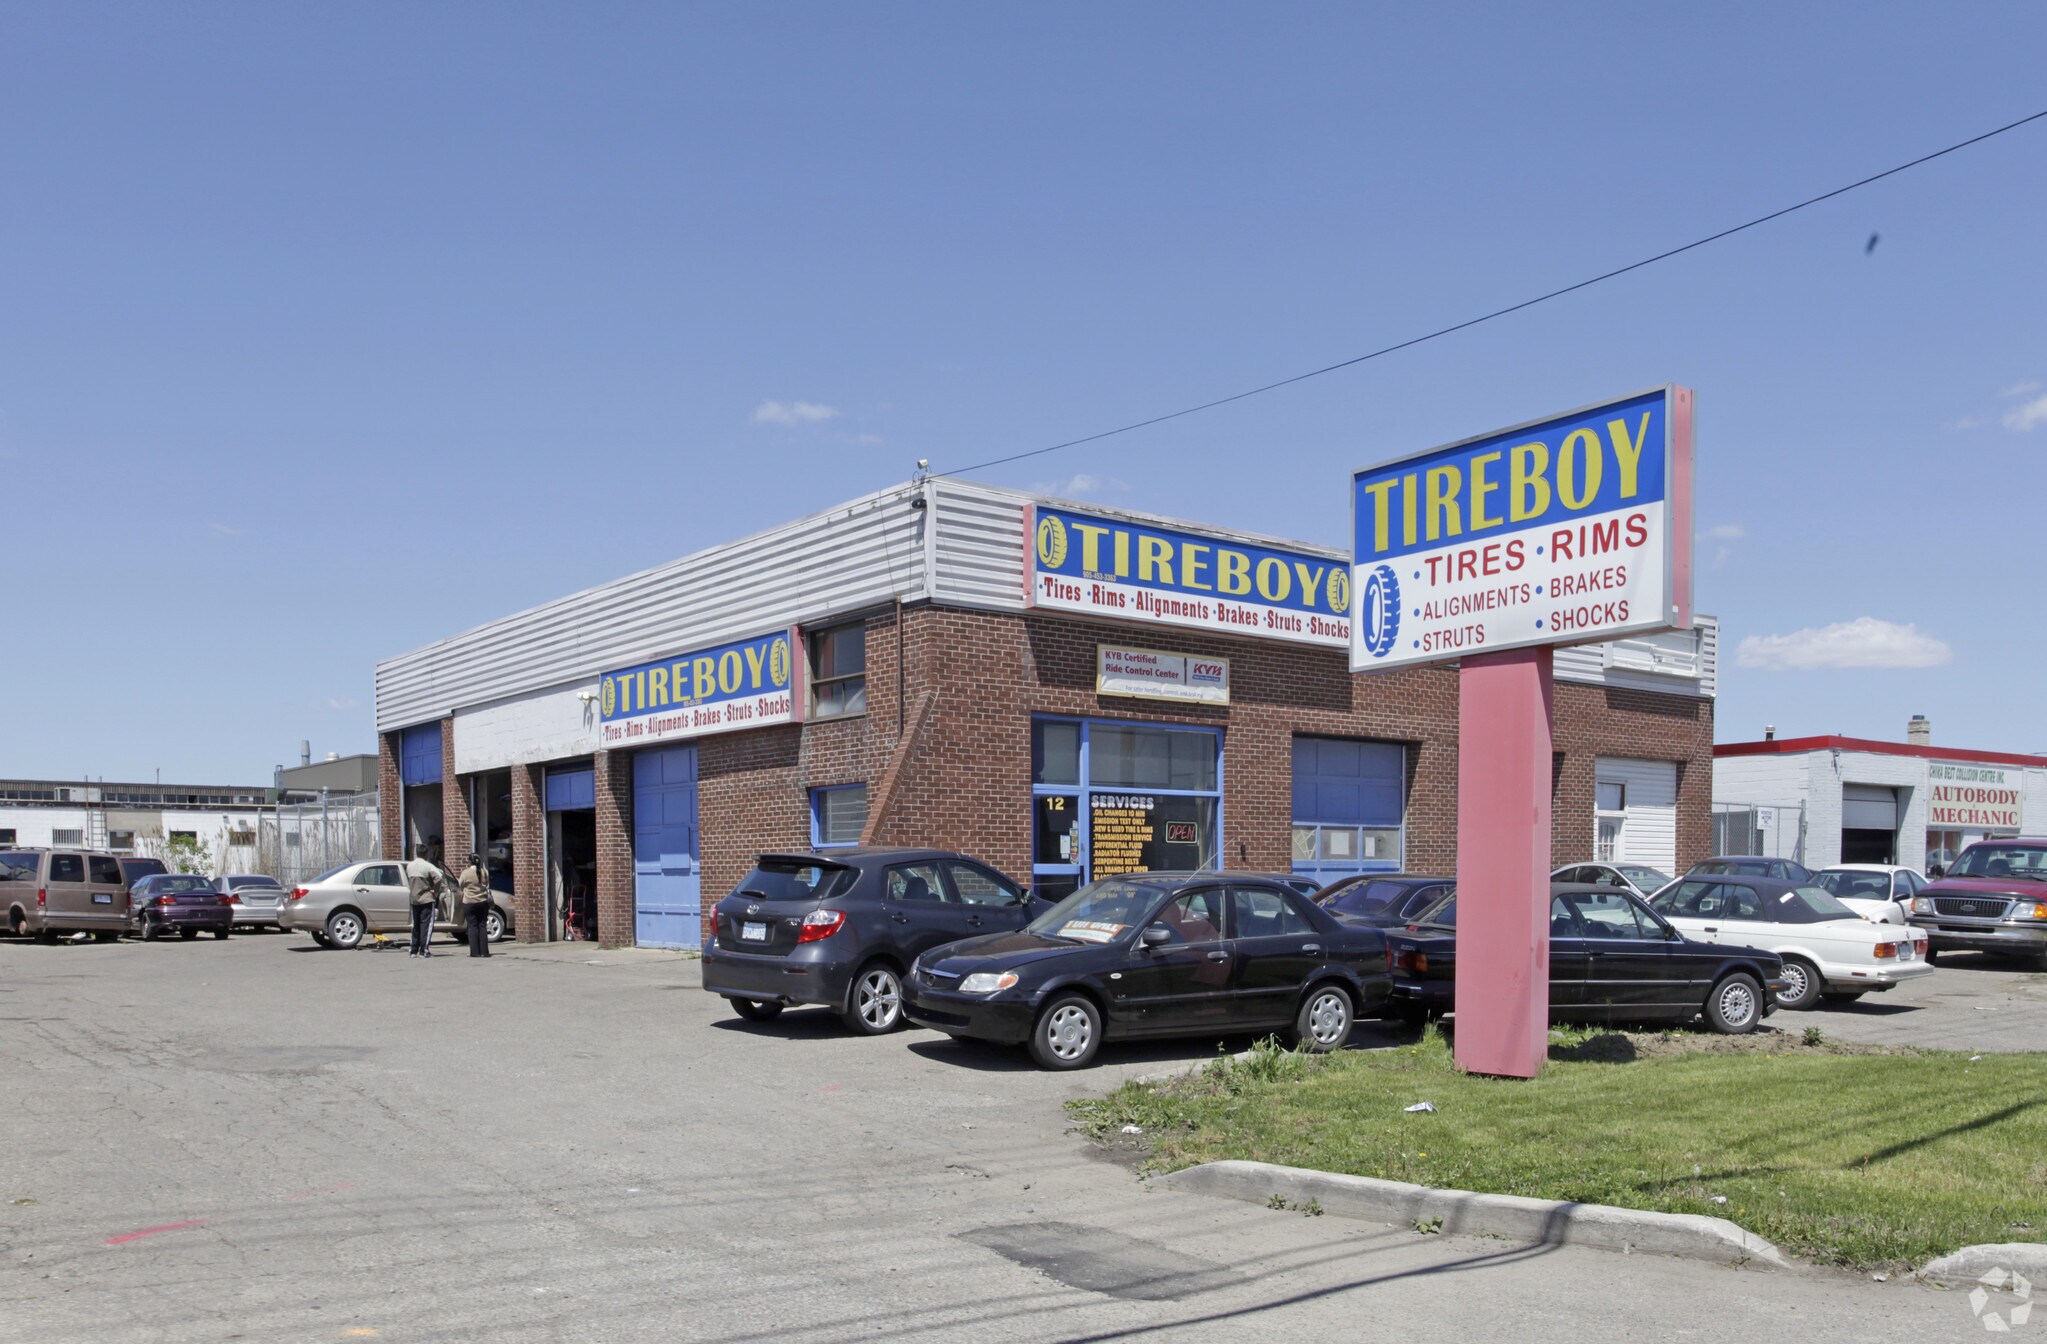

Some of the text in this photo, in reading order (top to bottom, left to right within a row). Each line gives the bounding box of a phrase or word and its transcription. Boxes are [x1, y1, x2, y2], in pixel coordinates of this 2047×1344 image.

[1365, 412, 1650, 552] TIREBOY
[1072, 522, 1324, 606] TIREBOY
[1425, 514, 1647, 586] TIRES RIMS
[1044, 576, 1349, 639] Tires Rims Alignments Brakes Struts Shocks
[1423, 566, 1626, 620] ALIGNMENTS BRAKES
[1423, 600, 1629, 651] STRUTS SHOCKS
[1106, 651, 1157, 664] KYB Certified
[1106, 664, 1179, 679] Ride Control Center
[616, 644, 767, 712] TIREBOY
[605, 695, 790, 741] Tires Rims Alignments Brakes Struts Shocks
[1944, 766, 1955, 780] BEST
[1956, 767, 1978, 782] COLLISION
[1979, 770, 1996, 783] CENTRE
[1047, 797, 1064, 810] 12
[1091, 795, 1154, 810] SERVICES
[1932, 785, 2018, 804] AUTOBODY
[1932, 807, 2018, 825] MECHANIC
[1168, 825, 1195, 840] OPEN
